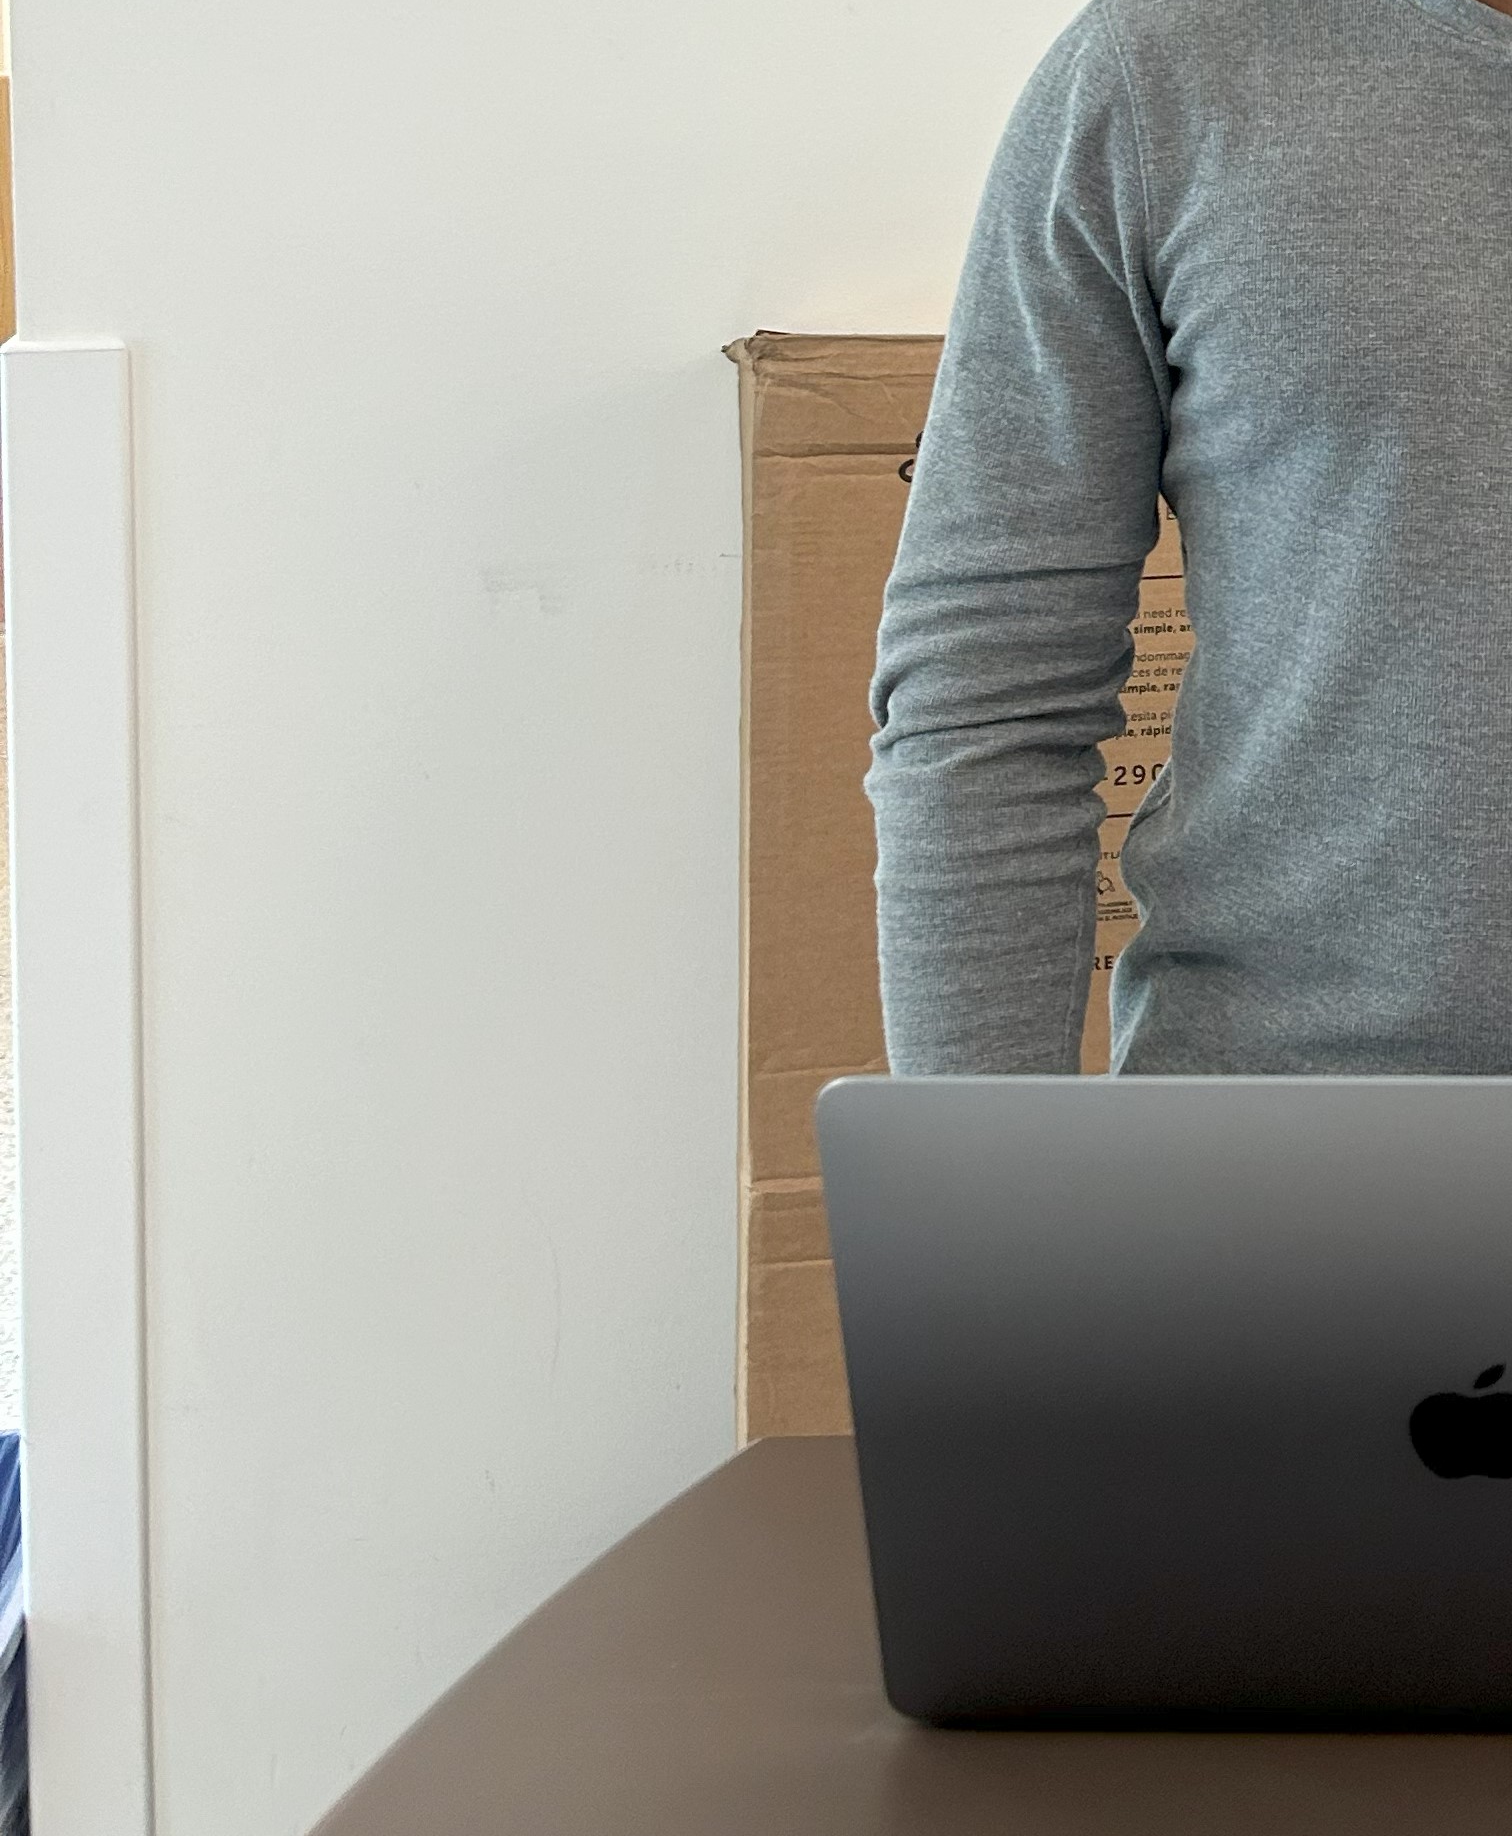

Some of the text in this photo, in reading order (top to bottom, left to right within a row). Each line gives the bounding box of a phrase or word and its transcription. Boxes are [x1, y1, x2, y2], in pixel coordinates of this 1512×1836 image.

[1143, 608, 1172, 619] need
[1133, 623, 1177, 635] simple,
[1153, 666, 1168, 677] de
